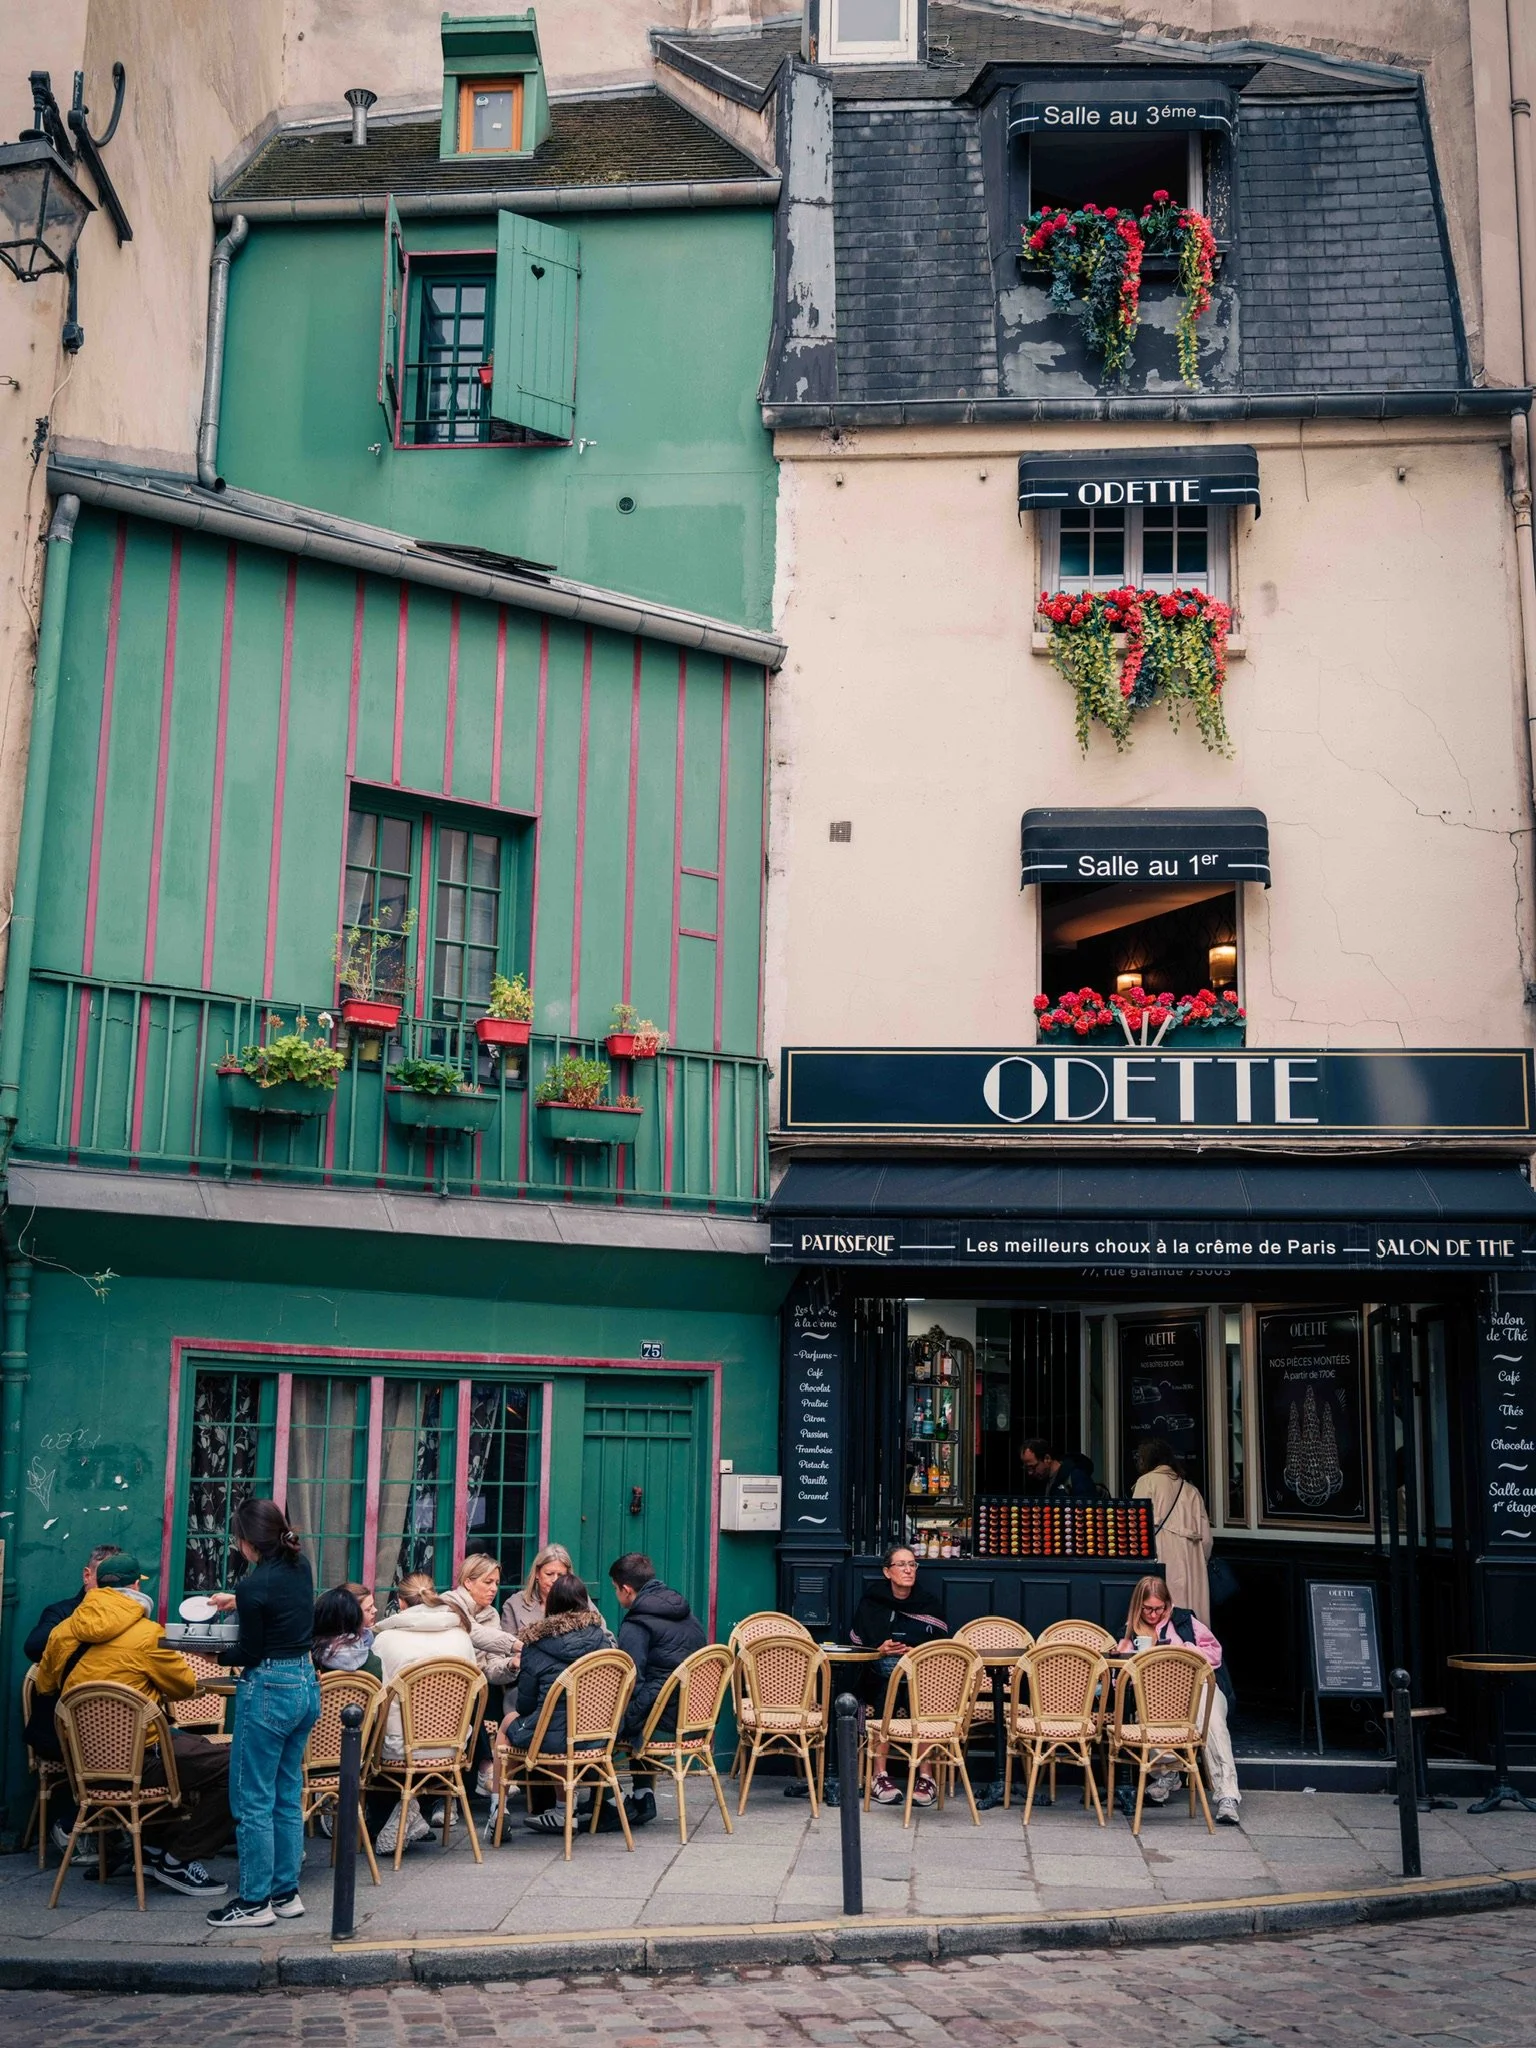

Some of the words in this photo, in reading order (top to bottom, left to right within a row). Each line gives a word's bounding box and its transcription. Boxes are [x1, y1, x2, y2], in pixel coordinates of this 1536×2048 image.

[1043, 106, 1101, 125] Salle
[1109, 111, 1138, 125] au
[1078, 480, 1200, 505] ODETTE
[1078, 855, 1139, 876] Salle
[1148, 861, 1179, 876] au
[1189, 854, 1219, 875] 1er
[983, 1056, 1319, 1124] ODETTE
[801, 1234, 895, 1256] PATISSERIE
[966, 1237, 998, 1252] Les
[1005, 1238, 1089, 1253] meilleurs
[1095, 1239, 1150, 1254] choux
[1156, 1239, 1167, 1254] à
[1173, 1239, 1189, 1254] la
[1195, 1239, 1252, 1254] crême
[1259, 1240, 1281, 1254] de
[1288, 1240, 1336, 1254] Paris
[1376, 1239, 1440, 1258] SALON
[1446, 1239, 1472, 1256] DE
[1477, 1239, 1515, 1257] THE
[1104, 1268, 1126, 1276] rue
[794, 1305, 808, 1316] Les
[794, 1319, 800, 1328] à
[802, 1317, 811, 1328] la
[812, 1318, 838, 1328] cème
[1290, 1321, 1328, 1337] ODETTE
[1145, 1332, 1176, 1345] ODETTE
[1486, 1328, 1500, 1341] de
[1502, 1327, 1528, 1342] Thé
[643, 1343, 661, 1358] 75
[1269, 1358, 1286, 1368] NOS
[1313, 1354, 1351, 1366] MONTÉES
[807, 1367, 824, 1380] Café
[1290, 1371, 1309, 1381] partir
[1308, 1370, 1318, 1379] de
[1498, 1370, 1521, 1386] Café
[799, 1383, 831, 1393] Chocolat
[801, 1398, 829, 1408] Praliné
[1498, 1404, 1524, 1416] Thés
[803, 1413, 826, 1423] Citron
[800, 1428, 829, 1439] Passion
[1490, 1438, 1535, 1451] Chocolat
[798, 1460, 829, 1469] Pistache
[799, 1475, 828, 1486] Vanille
[1488, 1481, 1521, 1497] Salle
[1522, 1488, 1536, 1497] au
[798, 1491, 829, 1501] Caramel
[1492, 1501, 1505, 1513] 1er
[1506, 1500, 1536, 1518] étage
